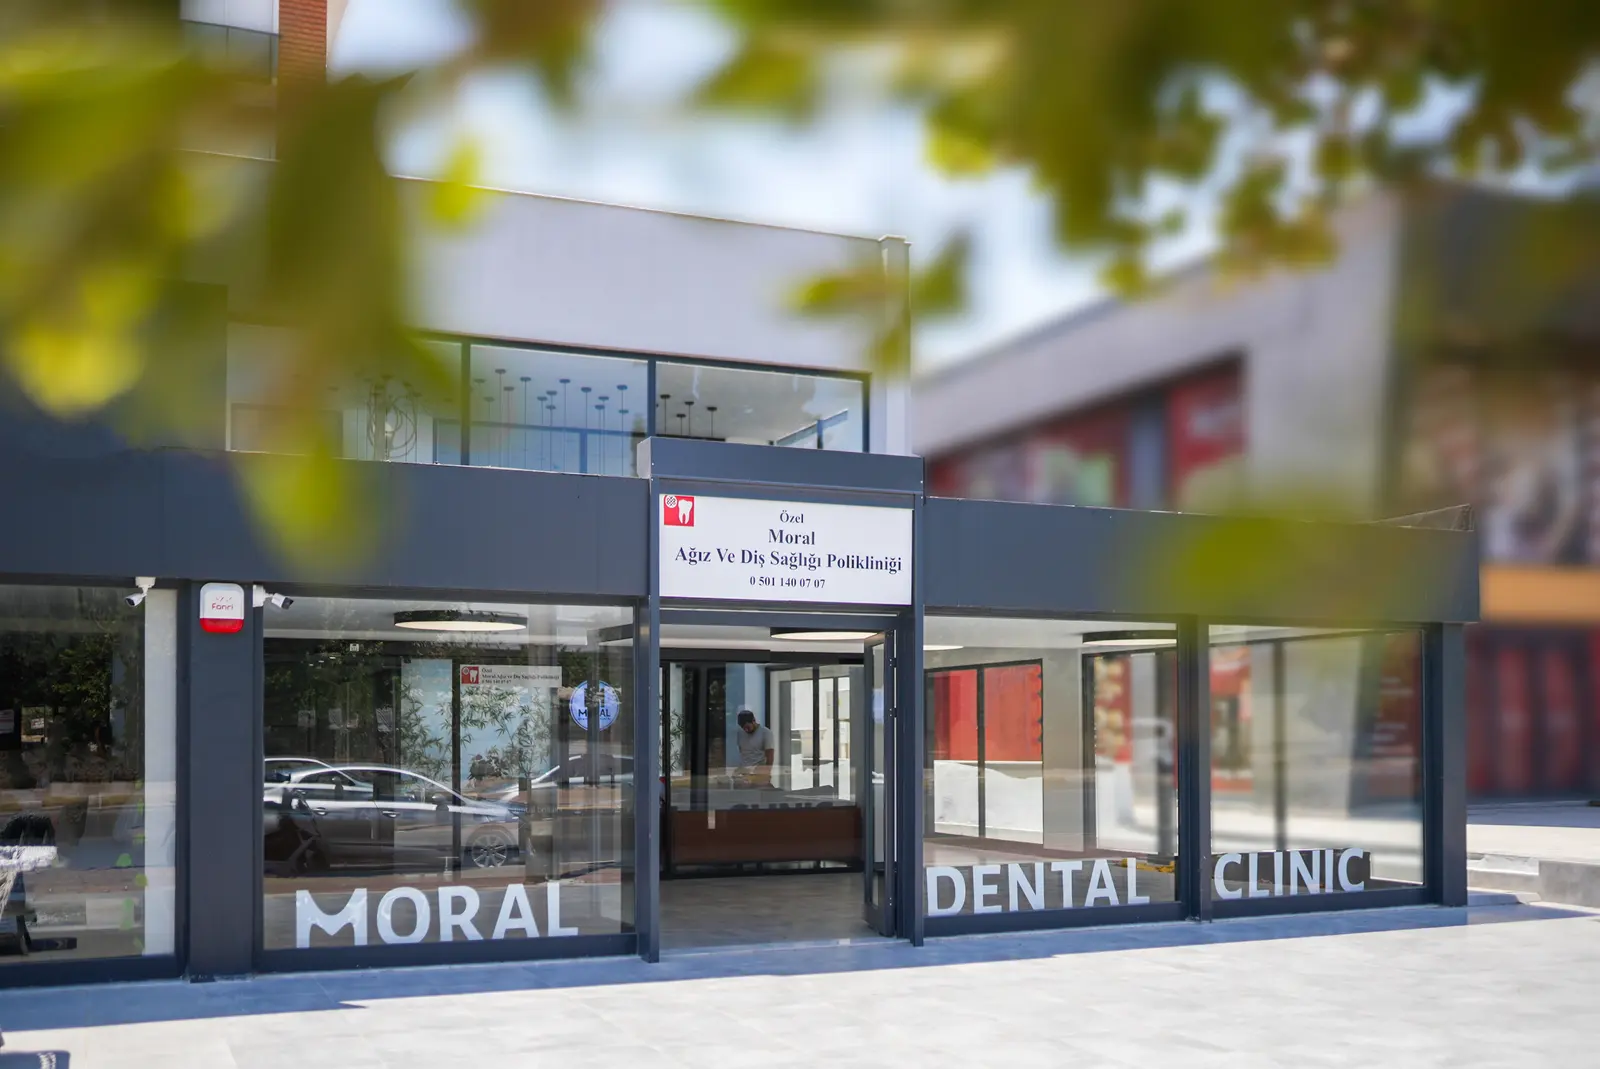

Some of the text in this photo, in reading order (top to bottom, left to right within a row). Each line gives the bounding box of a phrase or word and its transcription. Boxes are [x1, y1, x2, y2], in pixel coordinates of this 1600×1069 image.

[779, 510, 804, 524] Özel
[768, 529, 815, 545] Moral
[675, 547, 902, 574] Ağız Ve Diş Sağlığı Polikliniği
[750, 576, 826, 589] 0 501 140 07 07
[578, 708, 610, 717] MAL
[1214, 848, 1366, 900] CLINIC
[926, 857, 1150, 916] DENTAL
[296, 882, 579, 948] MORAL
